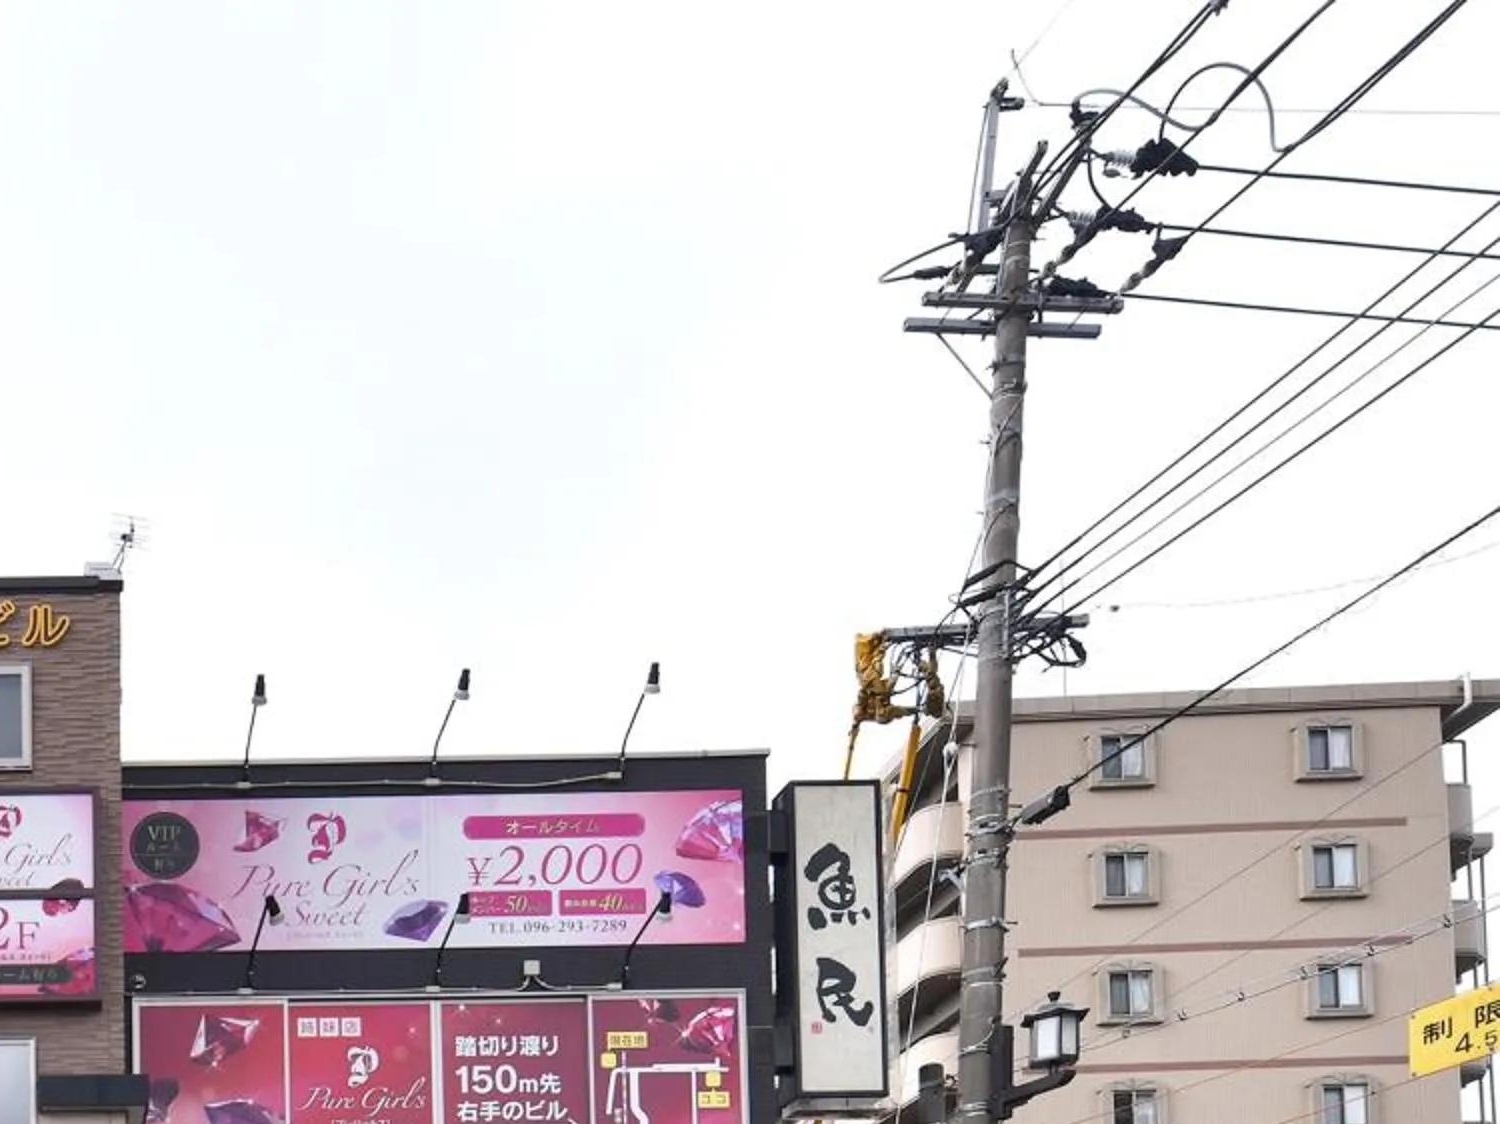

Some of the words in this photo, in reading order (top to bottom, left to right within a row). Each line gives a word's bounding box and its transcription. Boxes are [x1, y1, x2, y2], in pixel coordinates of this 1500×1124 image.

[147, 825, 182, 842] VIP
[504, 819, 602, 836] オールタイム
[466, 843, 644, 887] ¥2,000
[230, 863, 311, 899] Pure
[803, 842, 874, 1028] 魚民
[454, 1035, 559, 1057] 踏切り渡り
[454, 1063, 562, 1094] 150m先
[296, 1086, 356, 1111] Pure
[456, 1100, 569, 1122] 右手のビル
